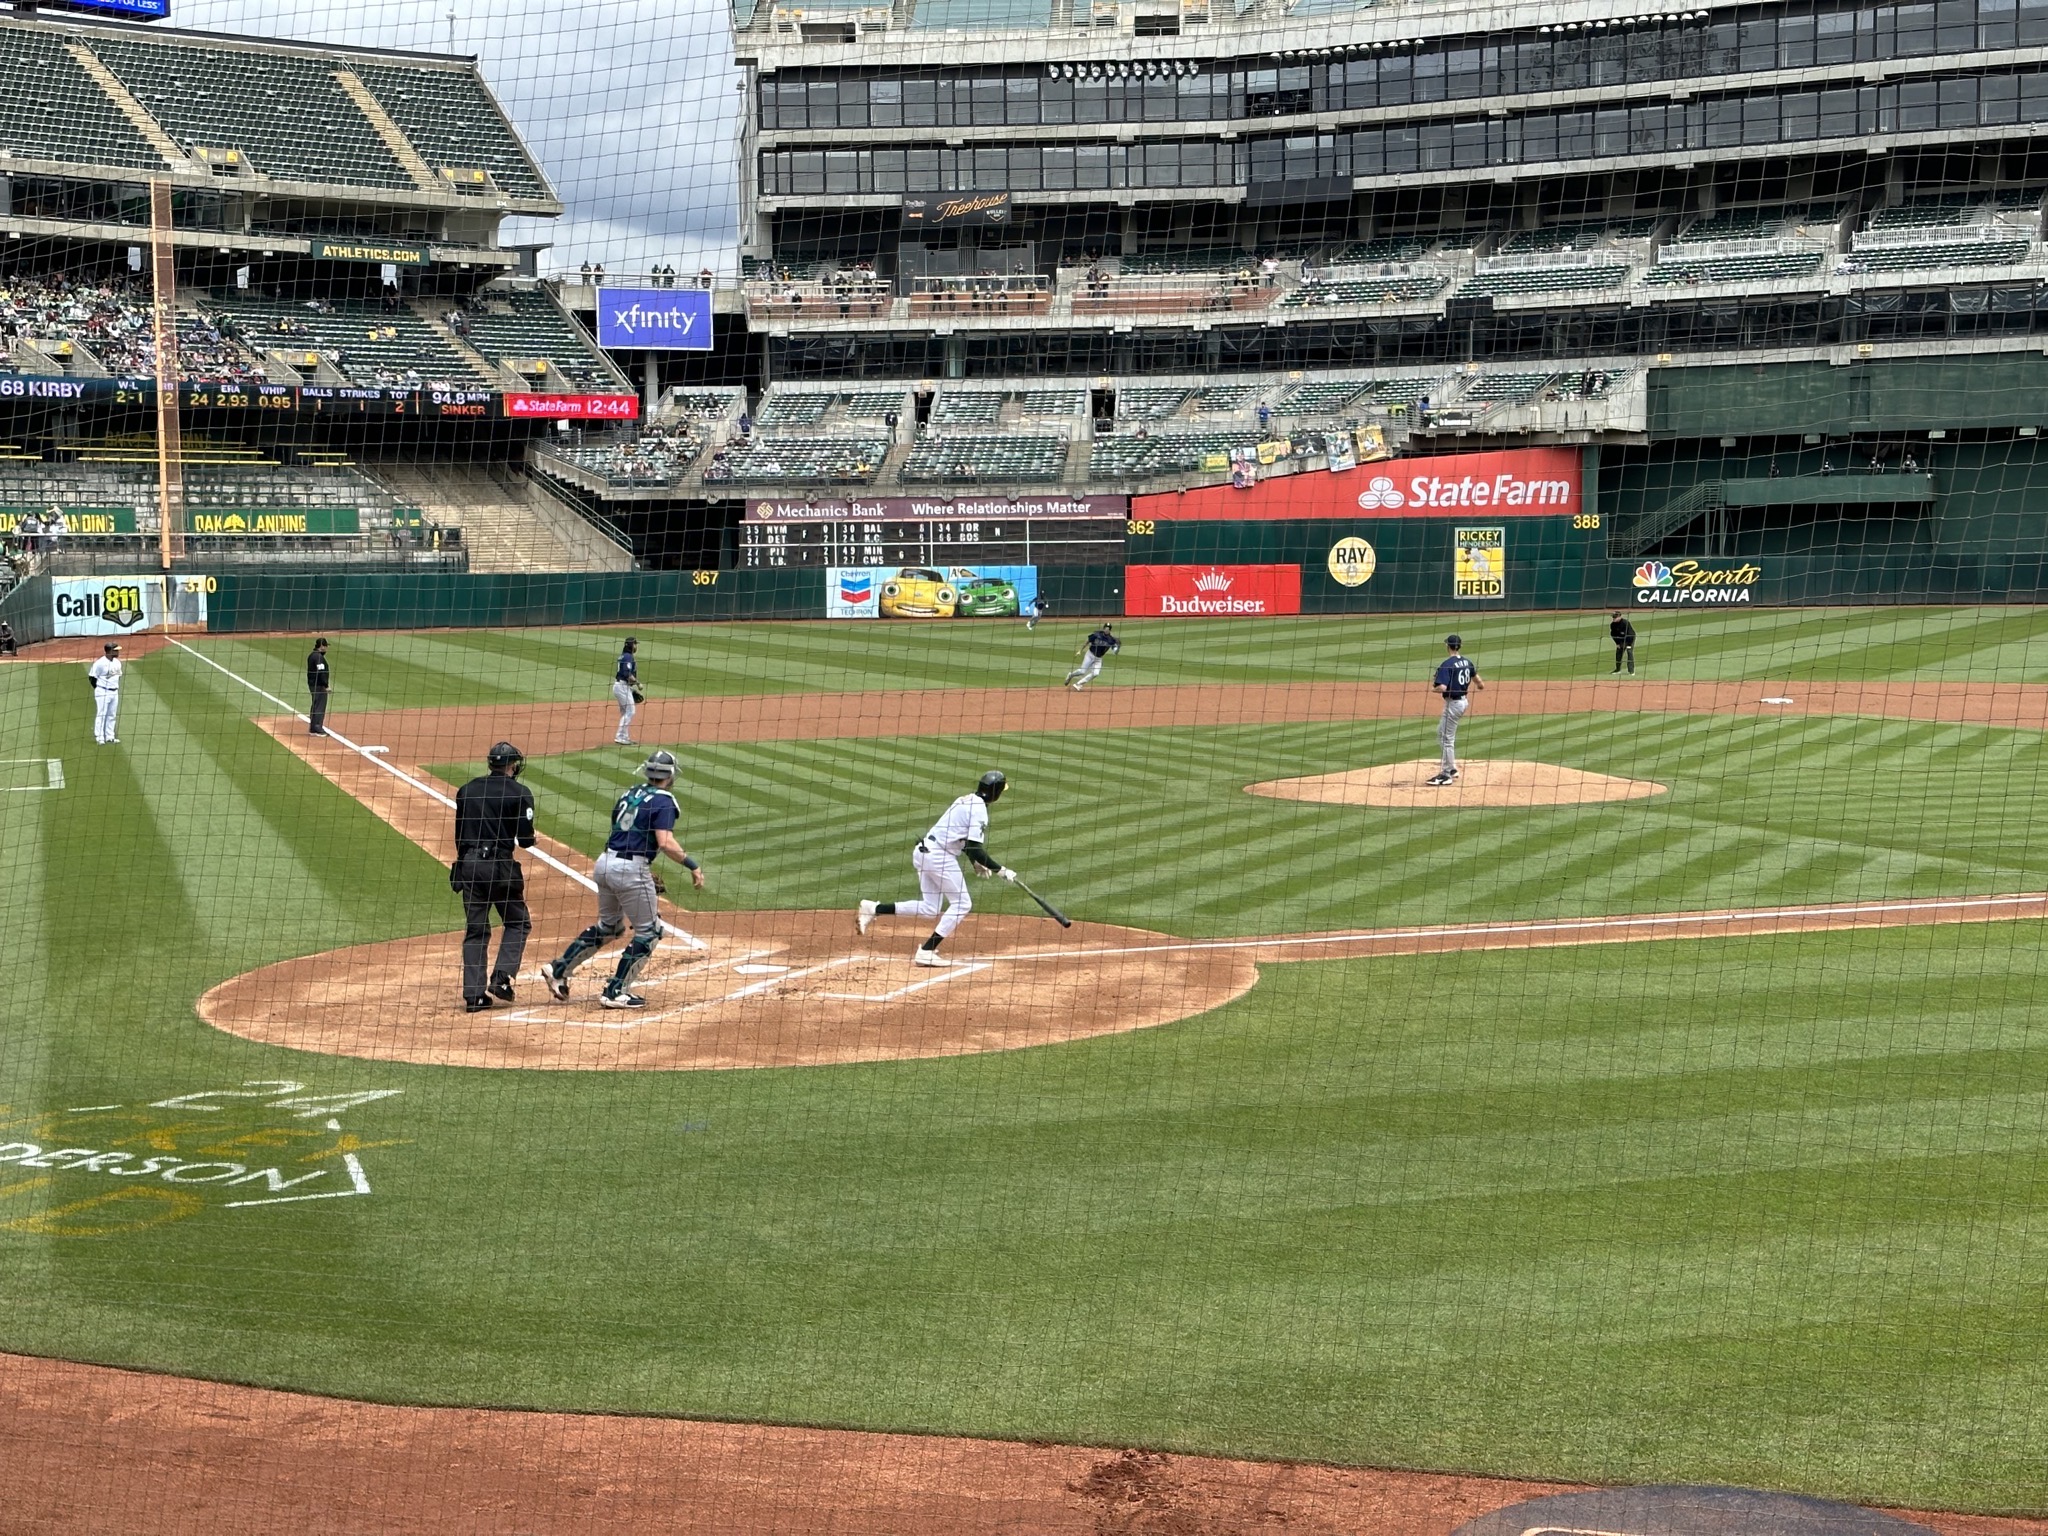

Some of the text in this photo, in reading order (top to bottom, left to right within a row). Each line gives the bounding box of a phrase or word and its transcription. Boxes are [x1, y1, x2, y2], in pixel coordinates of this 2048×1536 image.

[932, 192, 1008, 223] Treehouse
[322, 245, 420, 263] ATHLETICS.COM
[613, 303, 697, 335] xfinity
[0, 380, 85, 398] 68 KIRBY
[118, 380, 139, 390] W-L
[221, 385, 240, 394] ERA
[259, 386, 286, 395] WHIP
[302, 388, 409, 399] BALLS STRIKES TOT
[190, 394, 209, 406] 24
[216, 394, 249, 407] 2.93
[258, 396, 291, 409] 0.95
[432, 391, 491, 405] 94.8 MPH
[395, 401, 405, 413] 2
[441, 404, 486, 415] SINKER
[587, 400, 630, 415] 12:44
[777, 502, 1091, 517] Mechanics Bank Where Relationships Matter
[195, 514, 306, 533] OAK LANDING
[766, 525, 788, 534] NYM
[823, 524, 829, 534] 0
[863, 523, 882, 533] BAL
[960, 523, 979, 532] TOR
[1127, 520, 1155, 535] 362
[1573, 514, 1600, 529] 388
[767, 535, 787, 544] DET
[823, 534, 829, 543] 2
[960, 532, 979, 542] BOS
[1459, 530, 1499, 541] RICKEY
[769, 547, 786, 556] PIT
[823, 547, 829, 555] 2
[864, 546, 883, 555] MIN
[920, 546, 924, 555] 1
[898, 550, 904, 560] 6
[1336, 547, 1367, 564] RAY
[769, 557, 787, 566] T.B.
[823, 556, 829, 565] 3
[863, 555, 884, 565] CWS
[920, 555, 925, 564] 2
[692, 570, 719, 585] 367
[1671, 560, 1761, 592] Sports
[1459, 582, 1500, 595] FIELD
[1637, 588, 1750, 603] CALIFORNIA
[56, 586, 140, 617] Call 811
[1161, 595, 1264, 613] Budweiser
[840, 607, 873, 616] TECHRON
[1458, 668, 1471, 686] 68
